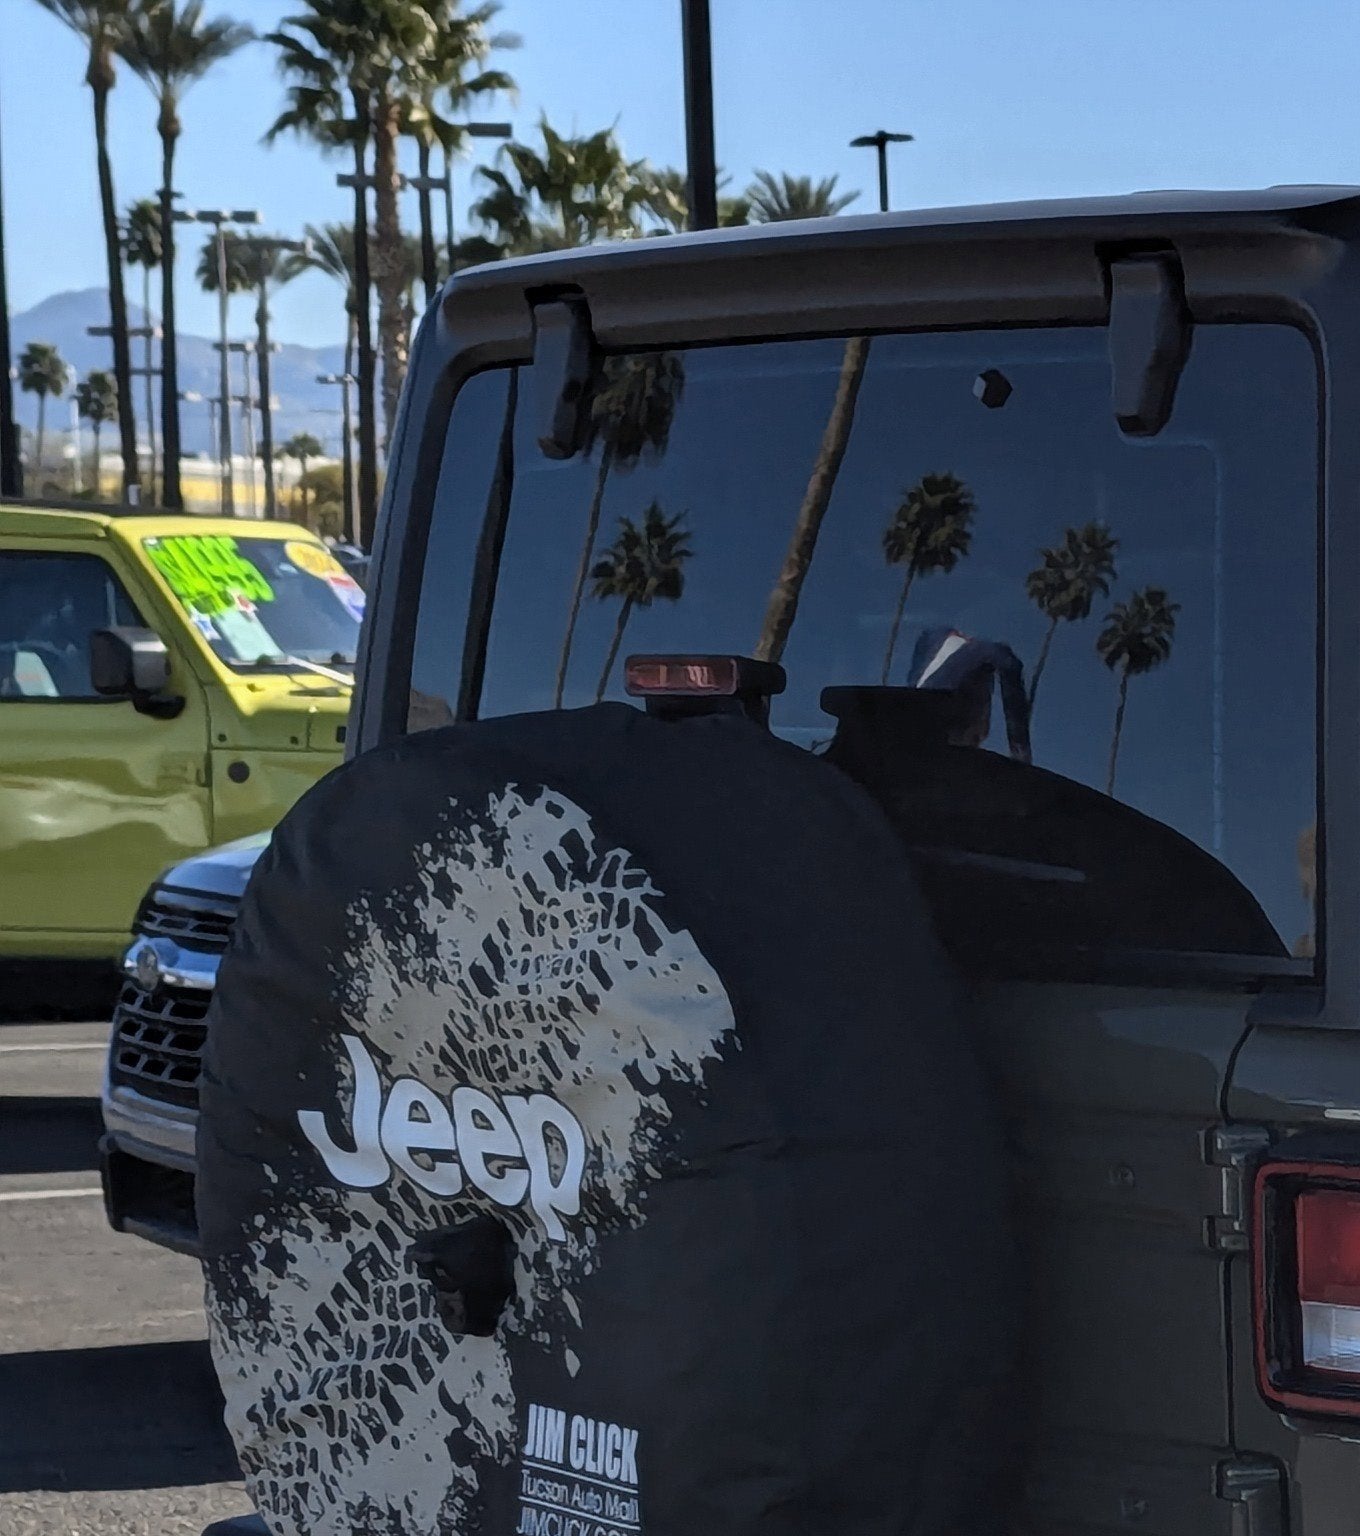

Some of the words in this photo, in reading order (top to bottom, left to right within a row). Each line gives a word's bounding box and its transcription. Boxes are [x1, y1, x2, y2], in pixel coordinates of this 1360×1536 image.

[297, 1033, 585, 1242] Jeep
[523, 1403, 566, 1464] JIM
[569, 1414, 639, 1485] CLICK
[521, 1468, 569, 1503] Tucson
[571, 1483, 602, 1514] Auto
[605, 1491, 640, 1523] Mall
